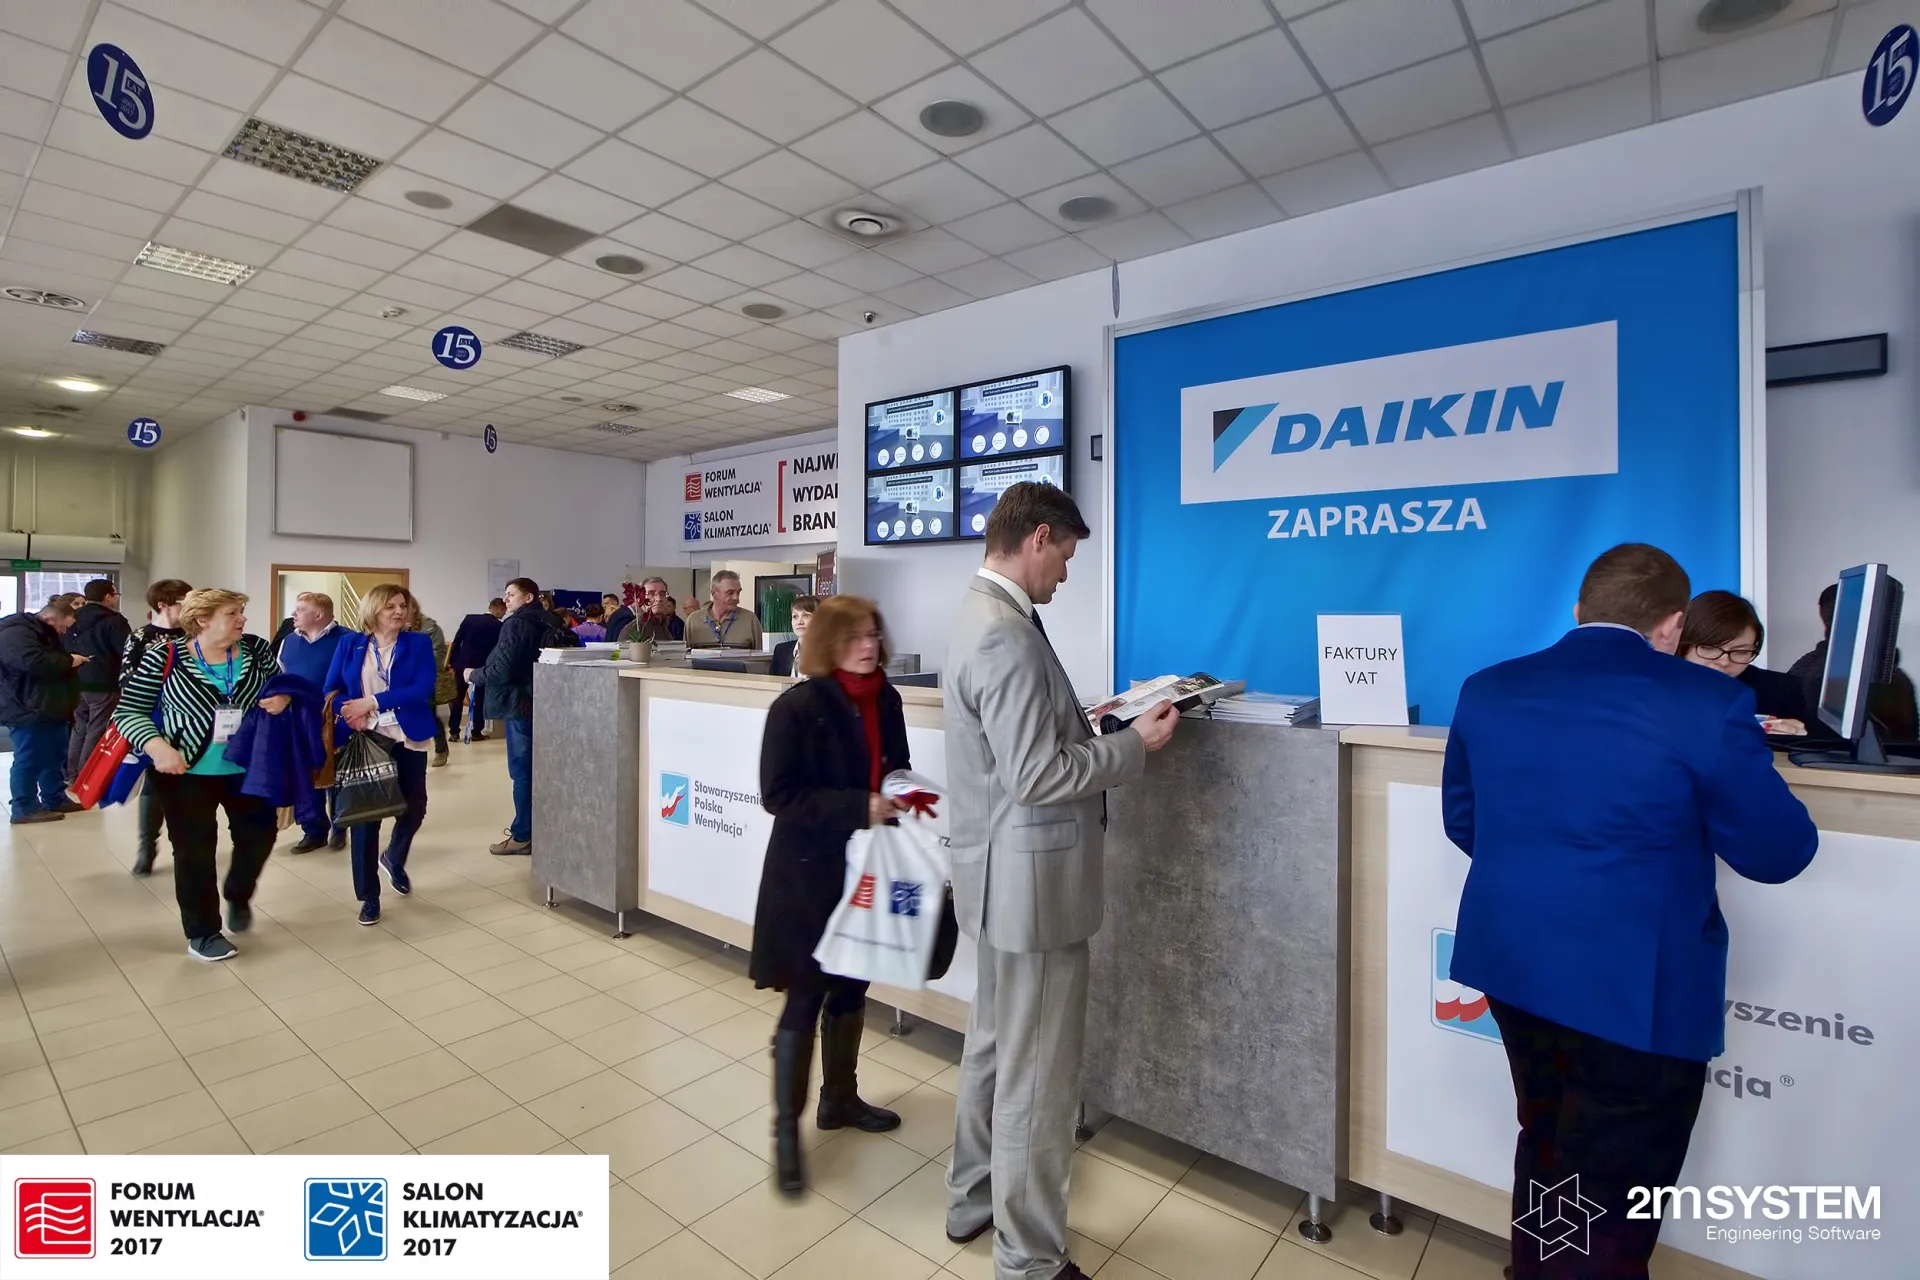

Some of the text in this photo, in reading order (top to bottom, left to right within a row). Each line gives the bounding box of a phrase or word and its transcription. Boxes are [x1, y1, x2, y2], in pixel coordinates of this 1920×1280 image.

[1867, 29, 1913, 116] 15
[94, 53, 147, 130] 15
[437, 333, 476, 364] 15
[1271, 380, 1564, 455] DAIKIN
[131, 422, 158, 444] 15
[486, 428, 496, 450] 15
[705, 468, 737, 483] FORUM
[704, 509, 734, 523] SALON
[1267, 498, 1487, 539] ZAPRASZA
[1324, 646, 1398, 661] FAKTURY
[1345, 671, 1378, 685] VAT
[694, 797, 723, 815] Polska
